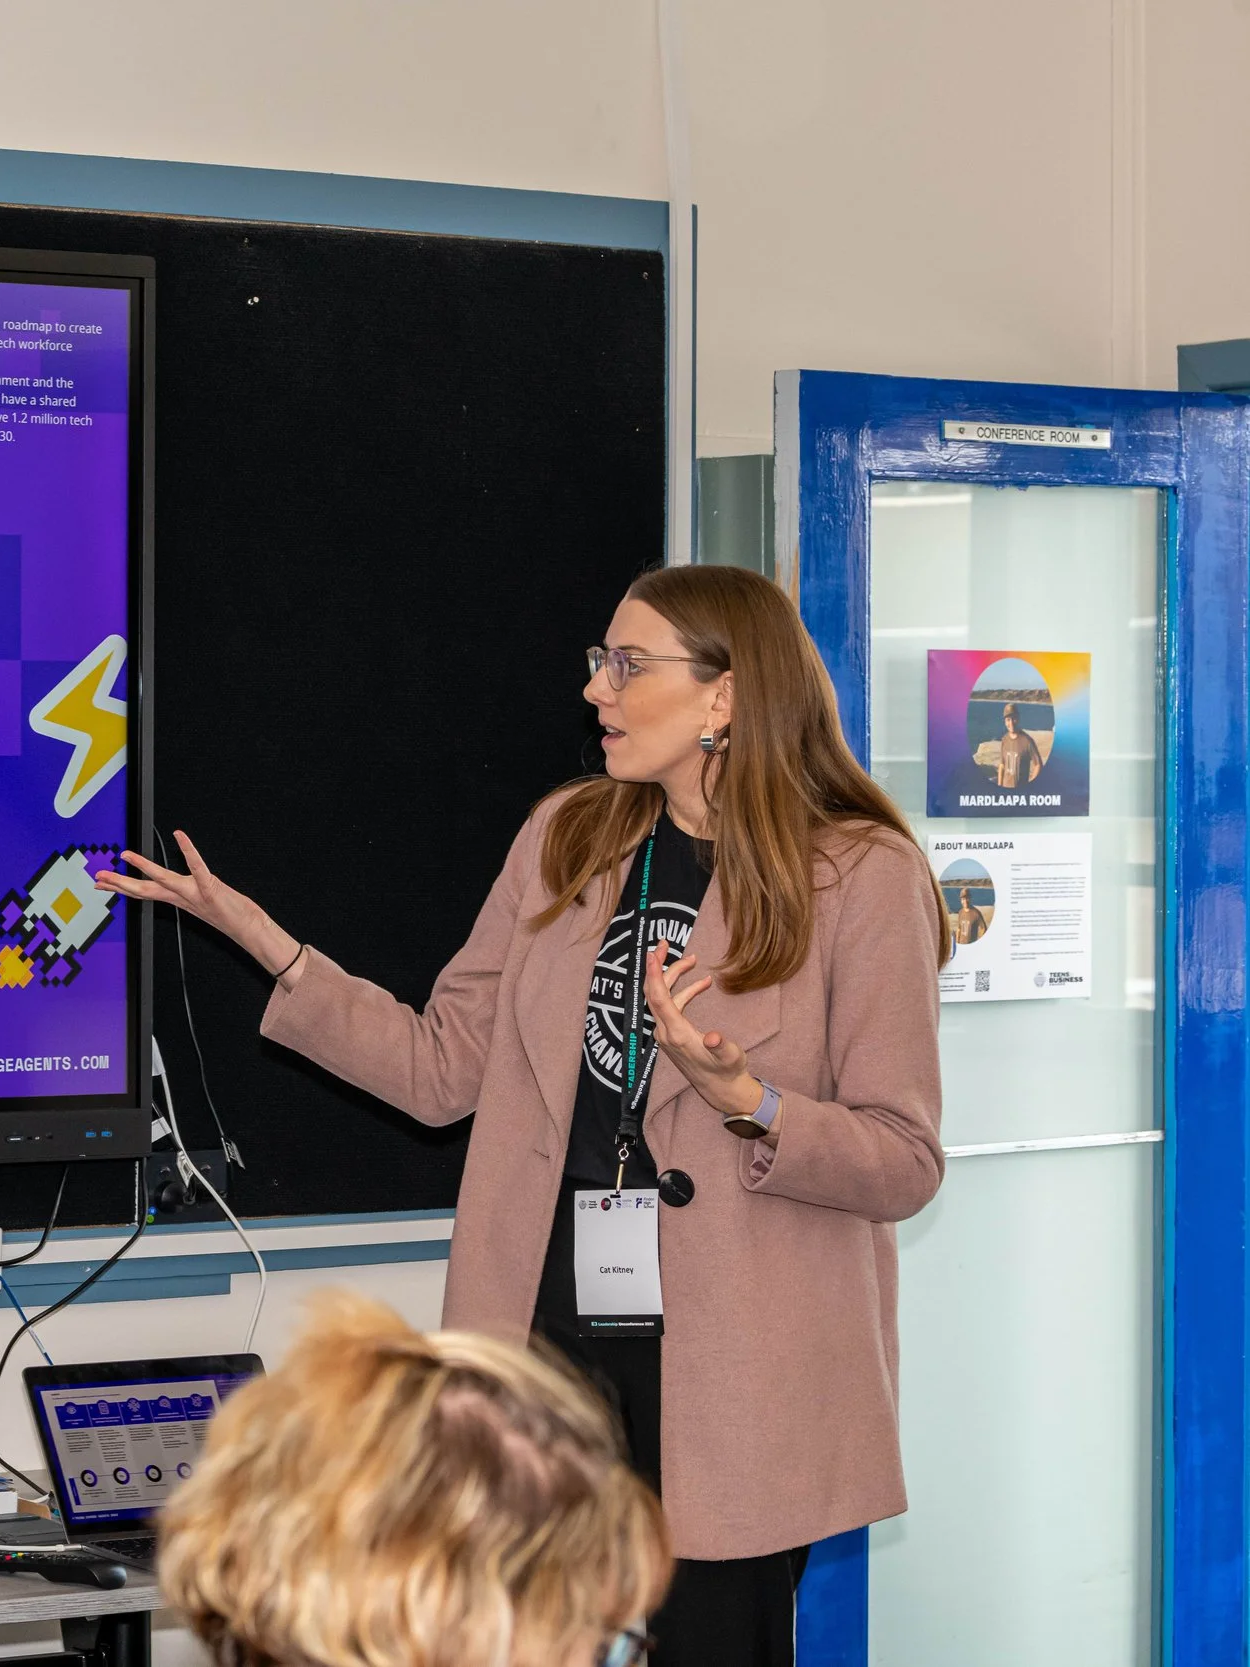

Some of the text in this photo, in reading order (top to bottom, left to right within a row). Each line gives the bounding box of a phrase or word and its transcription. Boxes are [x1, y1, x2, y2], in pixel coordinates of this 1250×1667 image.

[3, 319, 52, 334] roadmap
[54, 322, 66, 333] to
[68, 324, 102, 334] create
[18, 338, 72, 351] workforce
[32, 376, 53, 388] and
[55, 376, 74, 389] the
[1, 392, 27, 405] have
[29, 396, 36, 405] a
[39, 394, 76, 407] shared
[12, 412, 28, 424] 1.2
[30, 413, 67, 425] million
[69, 414, 92, 426] tech
[977, 427, 1080, 443] CONFERENCE ROOM
[959, 794, 1061, 806] MARDLAAPA ROOM
[934, 841, 1014, 850] ABOUT MARDLAAPA
[637, 916, 646, 946] Exchange
[634, 948, 642, 978] Education
[612, 1266, 634, 1275] Kitney
